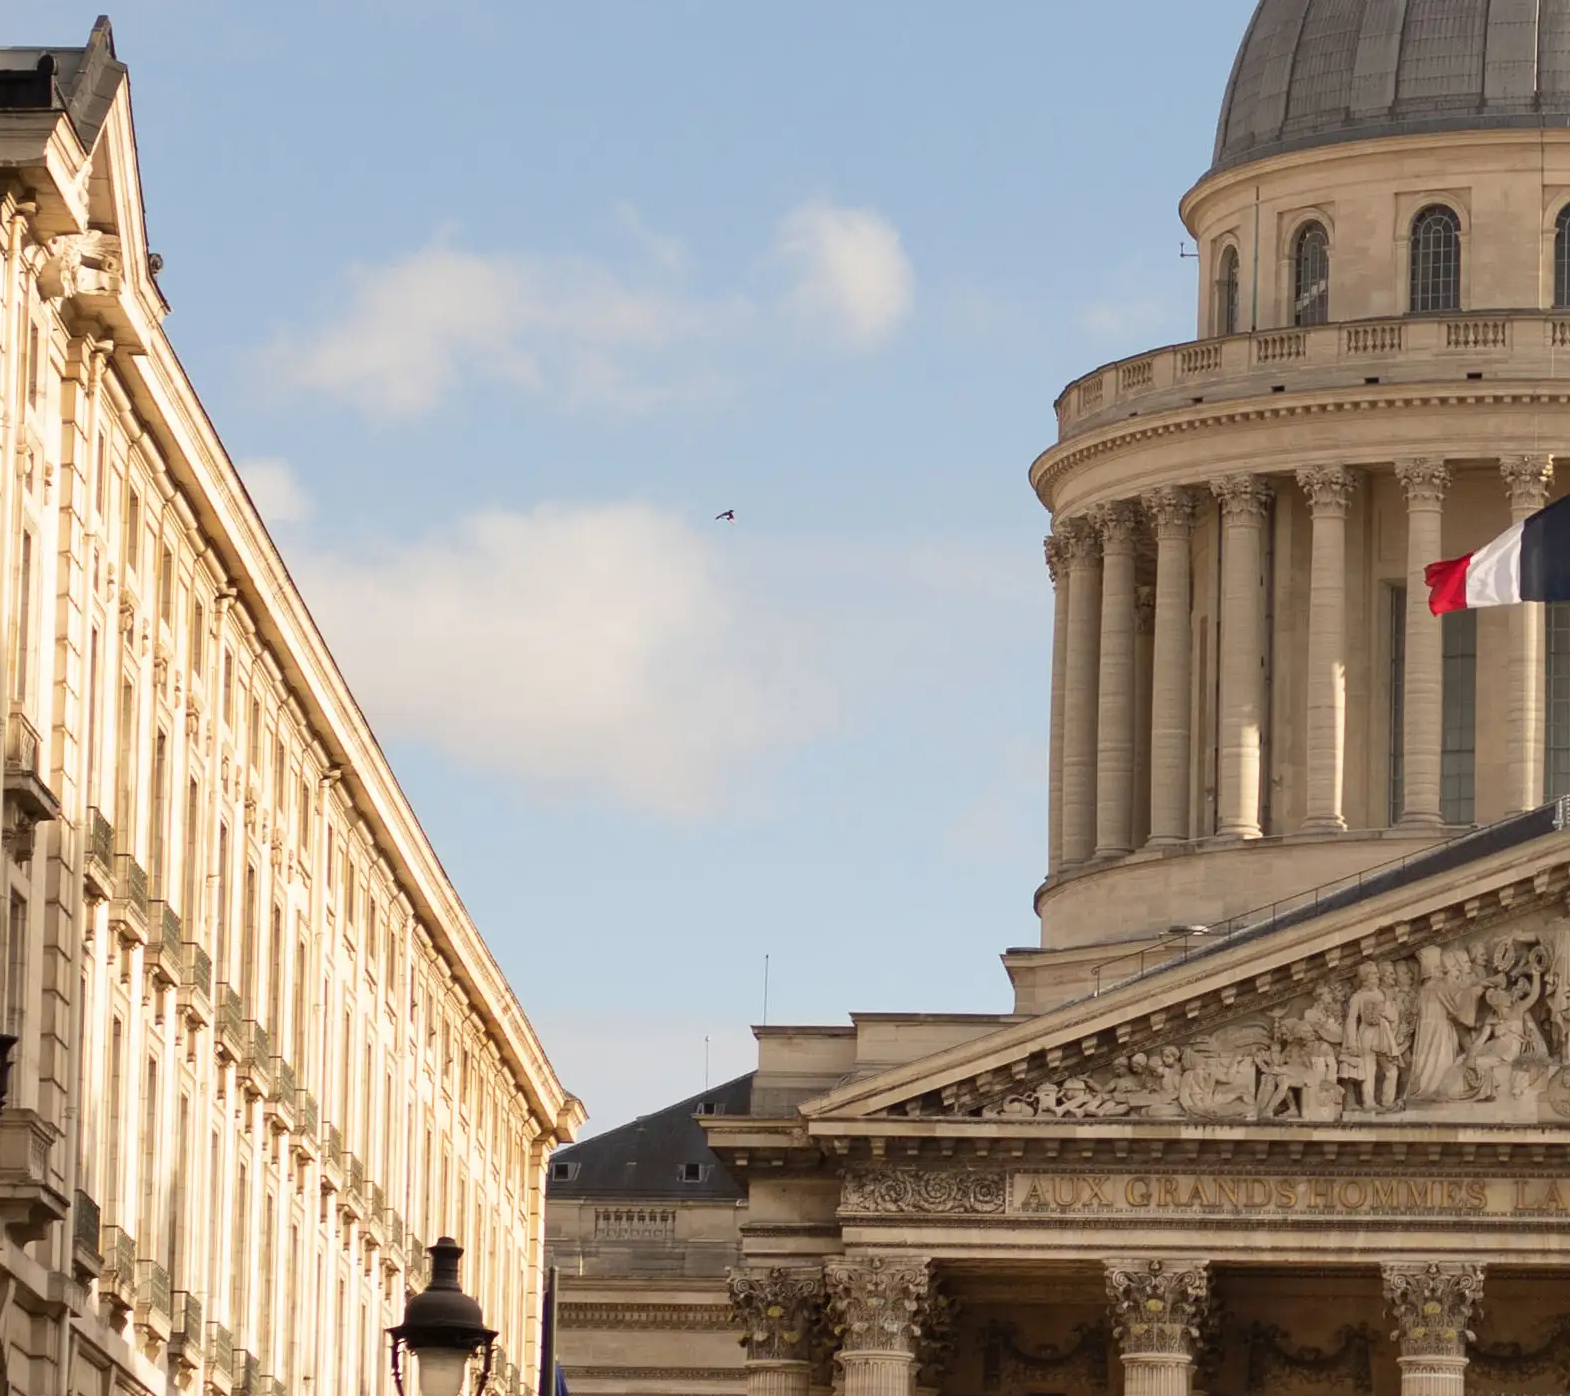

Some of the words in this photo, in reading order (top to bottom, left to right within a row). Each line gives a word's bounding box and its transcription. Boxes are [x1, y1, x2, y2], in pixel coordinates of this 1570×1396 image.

[1020, 1177, 1111, 1208] AUX
[1125, 1178, 1299, 1209] GRANDS
[1306, 1179, 1488, 1211] HOMMES
[1513, 1180, 1567, 1212] LA
